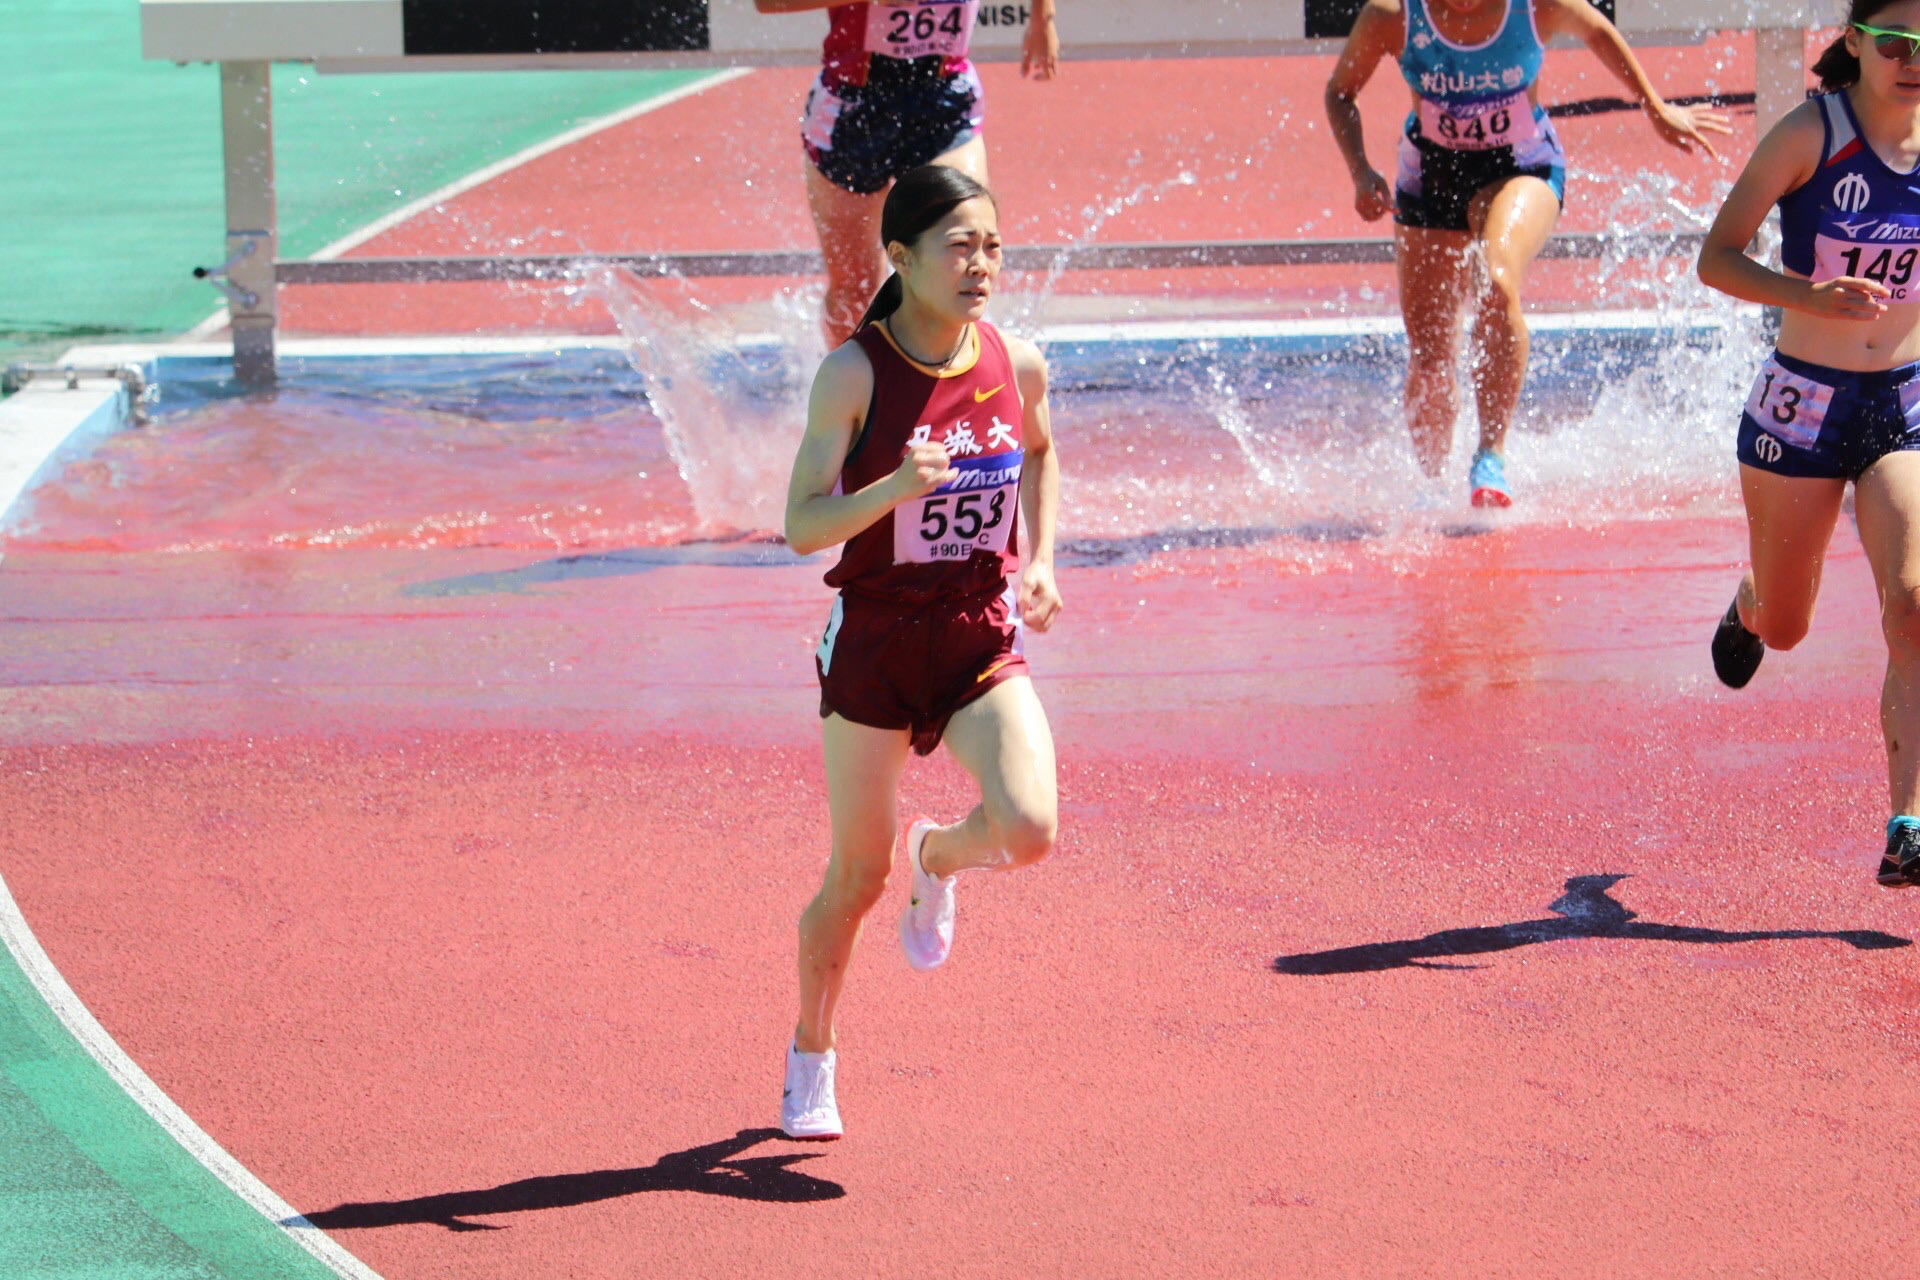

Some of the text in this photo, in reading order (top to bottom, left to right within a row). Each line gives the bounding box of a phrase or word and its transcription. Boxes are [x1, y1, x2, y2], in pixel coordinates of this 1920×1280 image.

[886, 6, 962, 43] 264
[1438, 109, 1511, 141] 840
[1840, 246, 1918, 285] 149
[1759, 371, 1802, 425] 13
[919, 490, 1005, 541] 553
